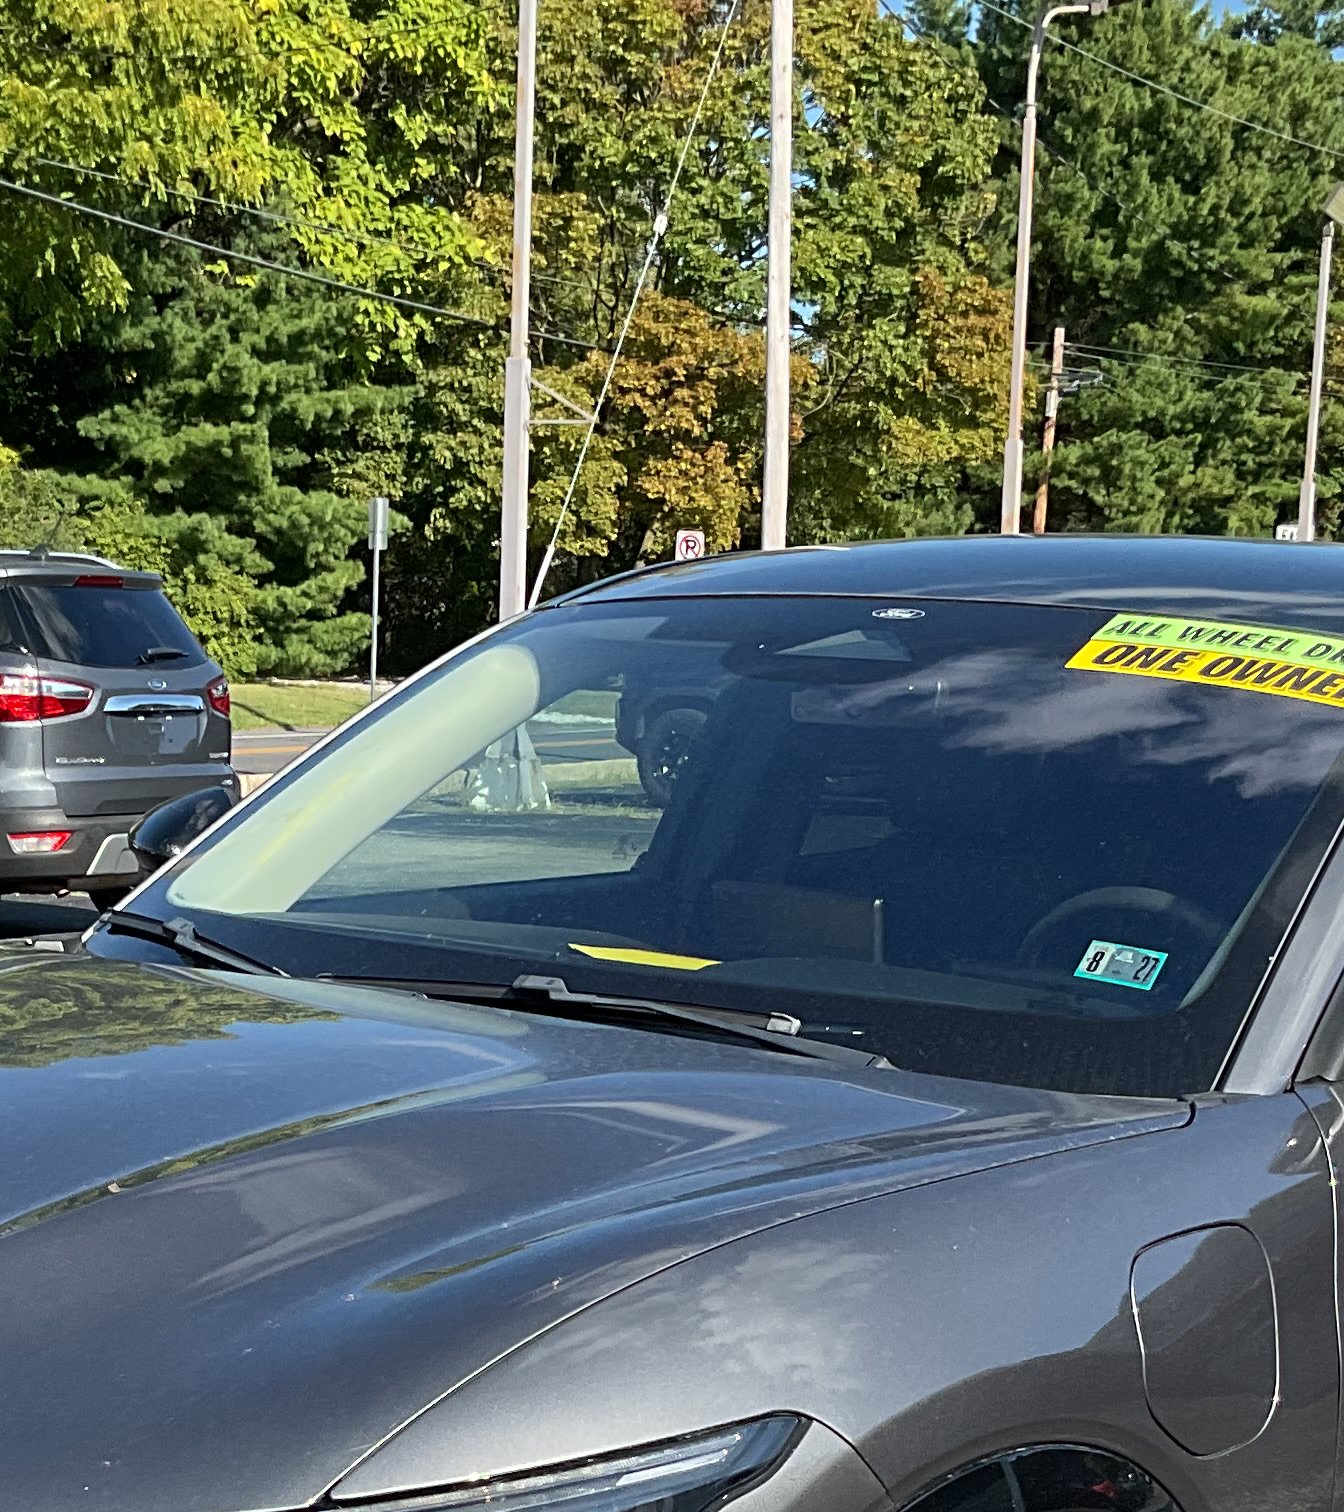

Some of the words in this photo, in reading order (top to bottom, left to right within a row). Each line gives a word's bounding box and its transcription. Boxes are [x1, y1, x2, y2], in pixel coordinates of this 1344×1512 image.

[1103, 620, 1171, 639] ALL
[1176, 625, 1299, 656] WHEEL
[1092, 644, 1203, 676] ONE
[1086, 951, 1106, 972] 8
[1132, 955, 1160, 983] 27
